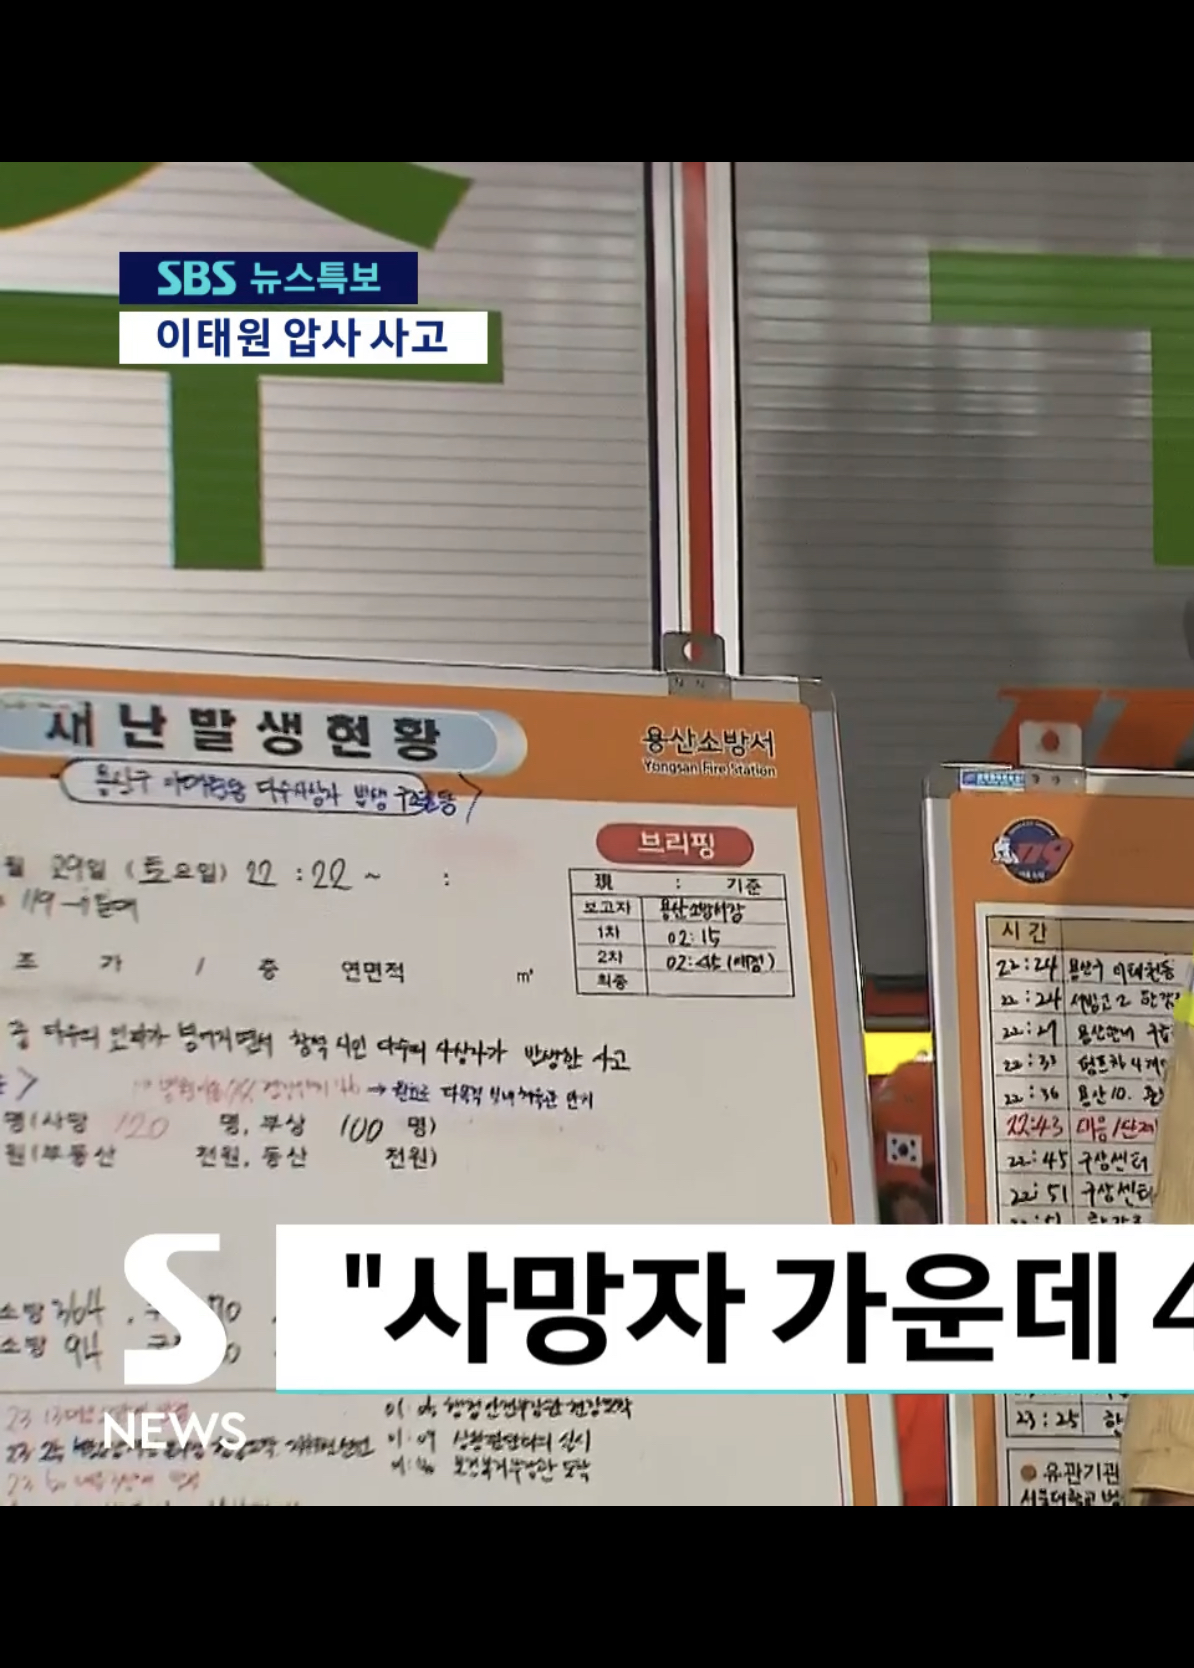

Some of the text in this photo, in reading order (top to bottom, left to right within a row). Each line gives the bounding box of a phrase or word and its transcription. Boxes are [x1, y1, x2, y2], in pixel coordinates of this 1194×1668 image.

[642, 726, 776, 757] 용산소방서
[643, 758, 776, 778] Yongsan Fire Station
[638, 831, 715, 859] 브리핑
[727, 877, 763, 896] 기준
[583, 901, 632, 915] 보고자
[597, 925, 621, 940] 1차
[597, 950, 623, 966] 2차
[340, 960, 406, 984] 연면적
